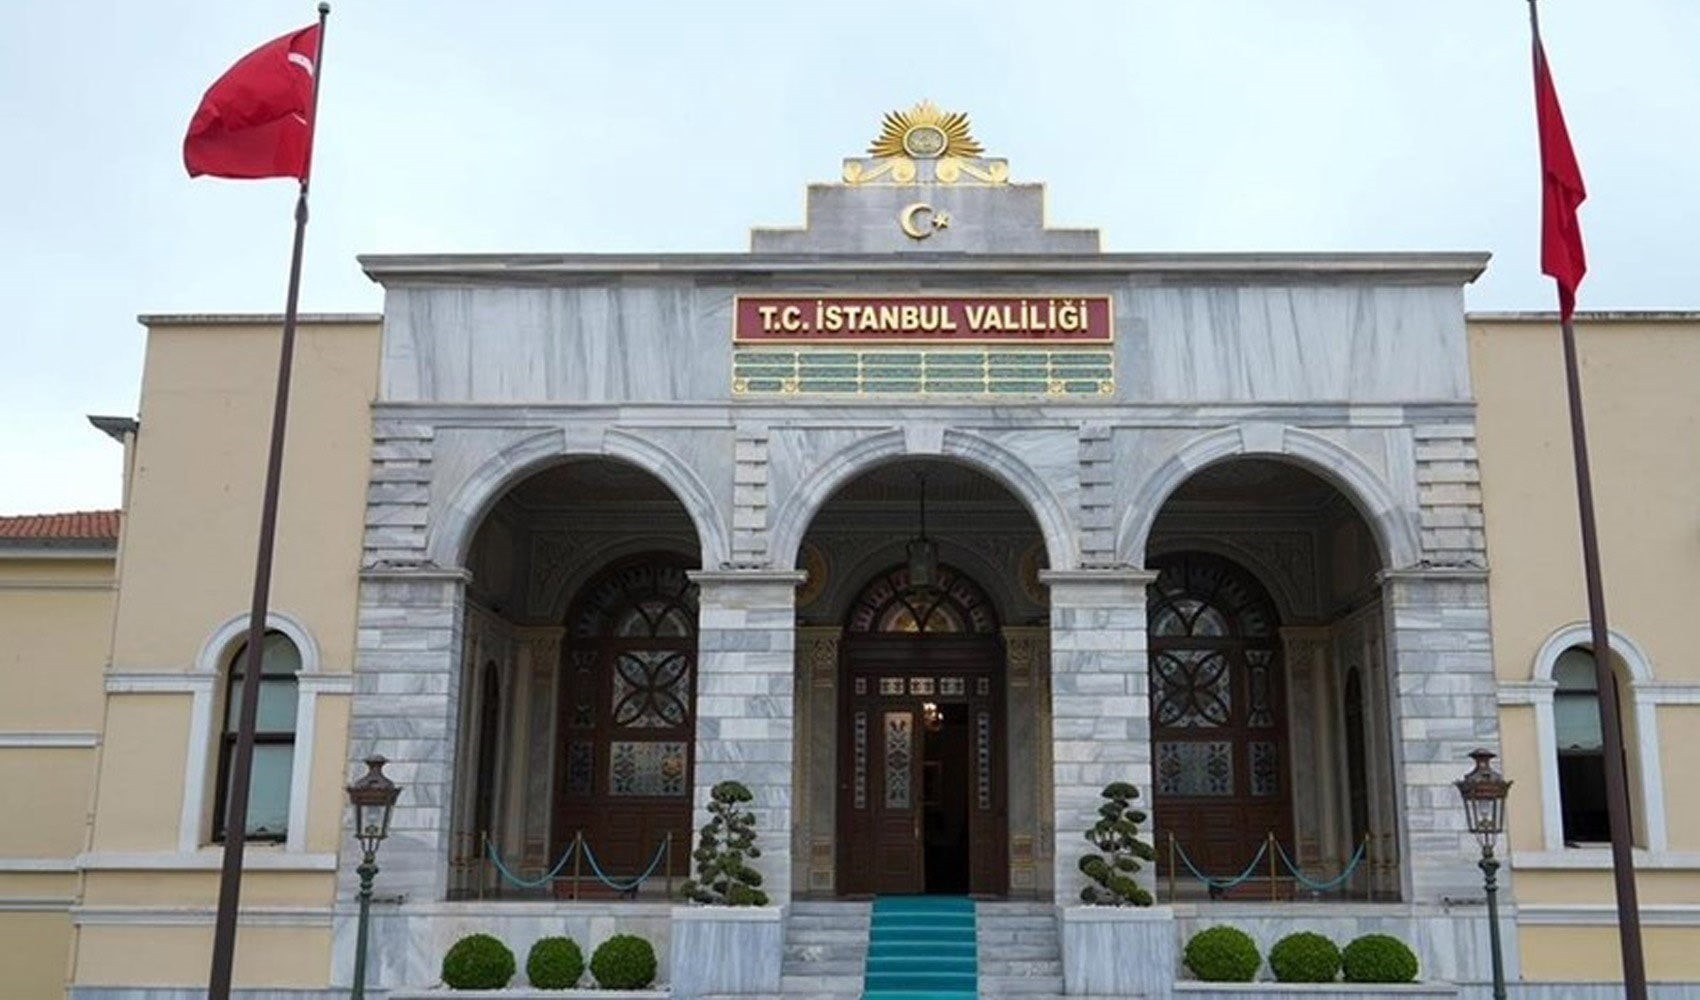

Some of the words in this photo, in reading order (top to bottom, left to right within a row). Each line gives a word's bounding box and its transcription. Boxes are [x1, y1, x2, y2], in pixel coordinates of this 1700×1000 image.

[759, 305, 809, 330] T.C.
[815, 299, 956, 330] İSTANBUL
[965, 298, 1088, 330] VALİLİĞİ
